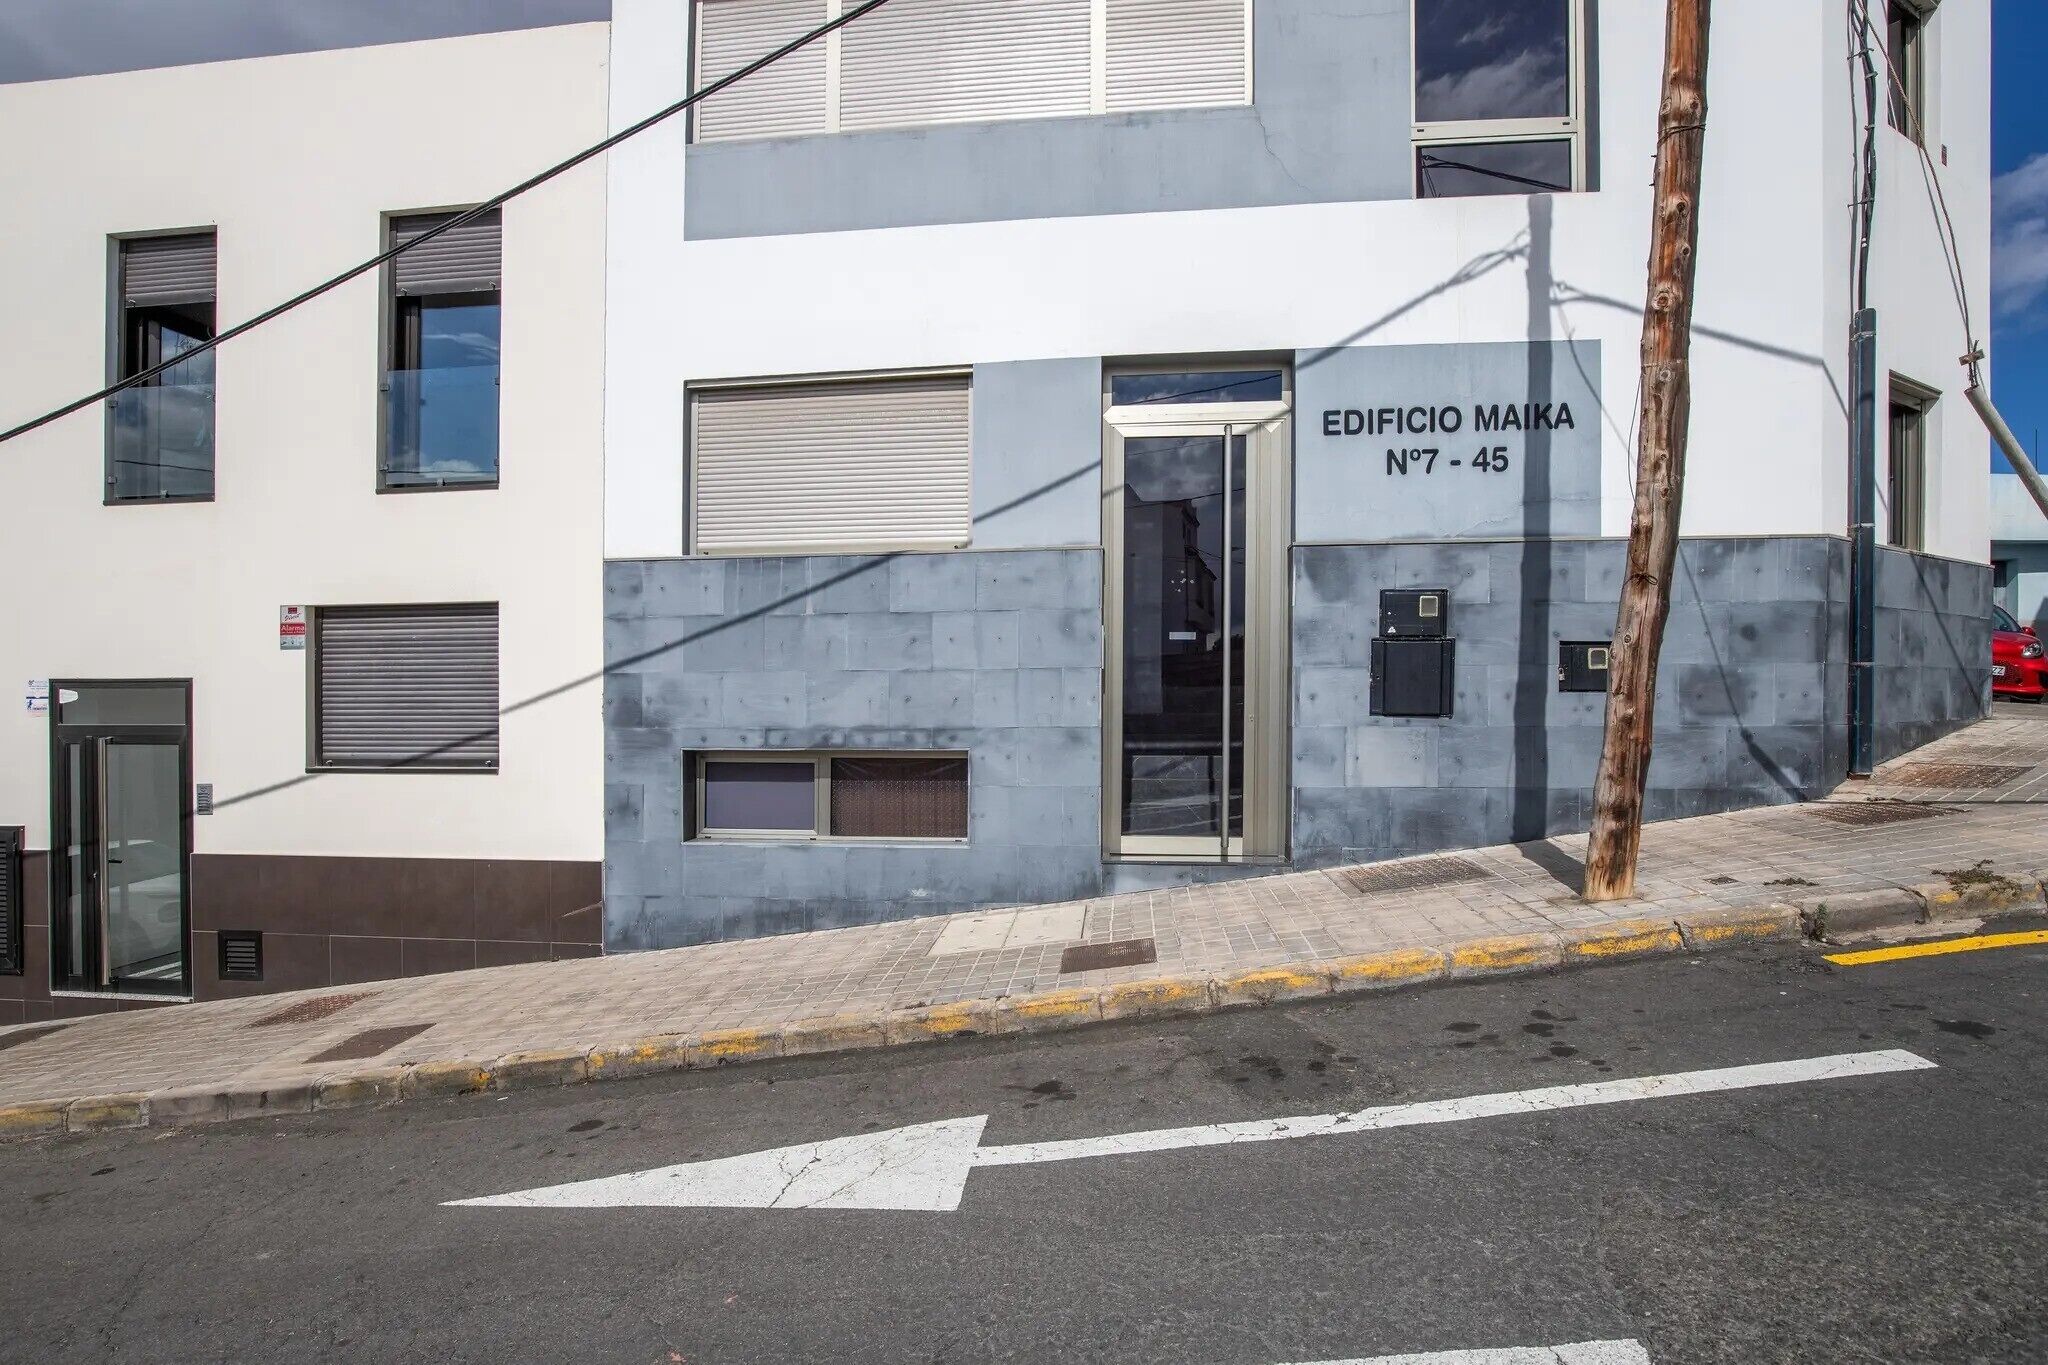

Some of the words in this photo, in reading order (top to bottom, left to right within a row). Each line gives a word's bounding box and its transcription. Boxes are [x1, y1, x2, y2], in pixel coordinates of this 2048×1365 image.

[1323, 406, 1463, 436] EDIFICIO
[1474, 403, 1575, 431] MAIKA
[1471, 446, 1509, 473] 45
